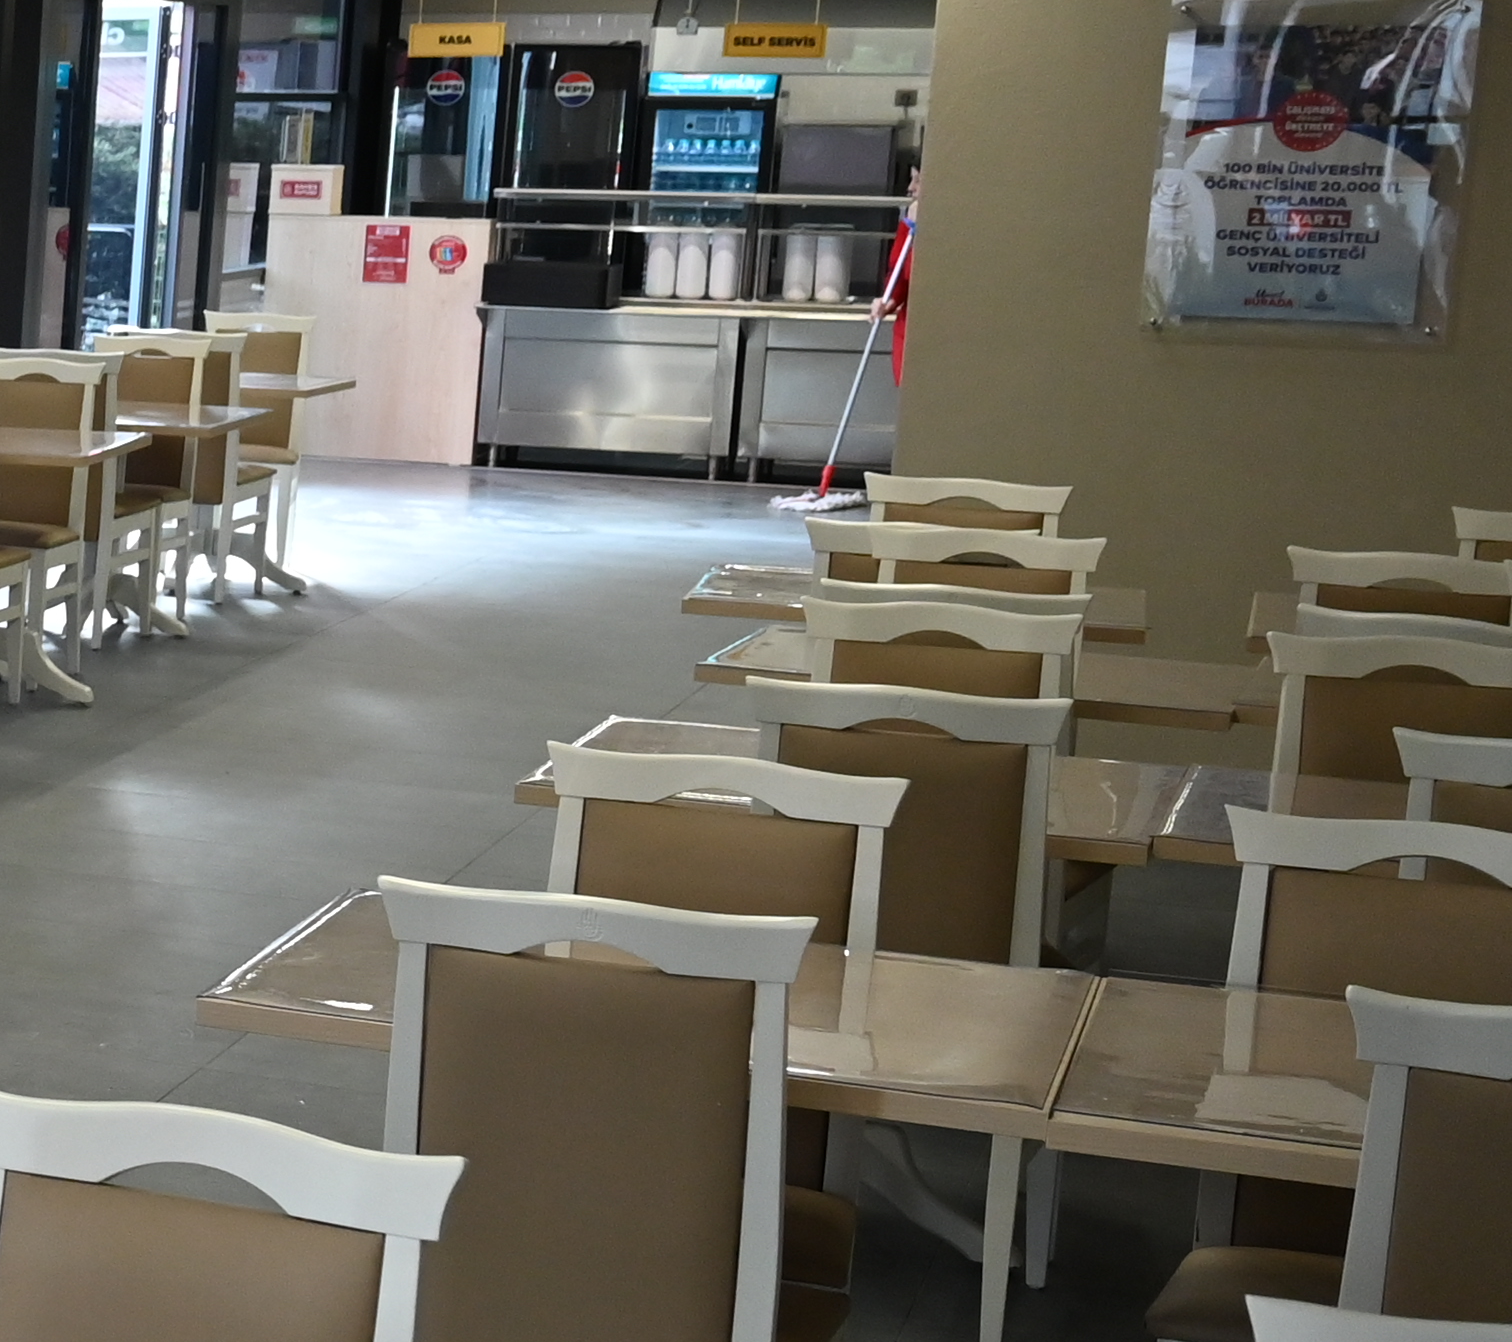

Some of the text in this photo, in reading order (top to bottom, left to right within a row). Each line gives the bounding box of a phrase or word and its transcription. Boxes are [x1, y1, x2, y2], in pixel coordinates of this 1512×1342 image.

[438, 35, 473, 45] KASA
[733, 35, 816, 48] SELF SERVİS
[1223, 162, 1252, 174] 100
[1256, 162, 1283, 175] BİN
[1204, 176, 1317, 192] ÖĞRENCİSİNE
[1320, 181, 1381, 193] 20.000
[1254, 194, 1348, 208] TOPLAMDA
[1250, 212, 1348, 226] 2 MİLYAR TL
[1216, 229, 1262, 243] GENÇ
[1226, 245, 1367, 260] SOSYAL DESTEĞİ
[1247, 260, 1342, 276] VERİYORUZ
